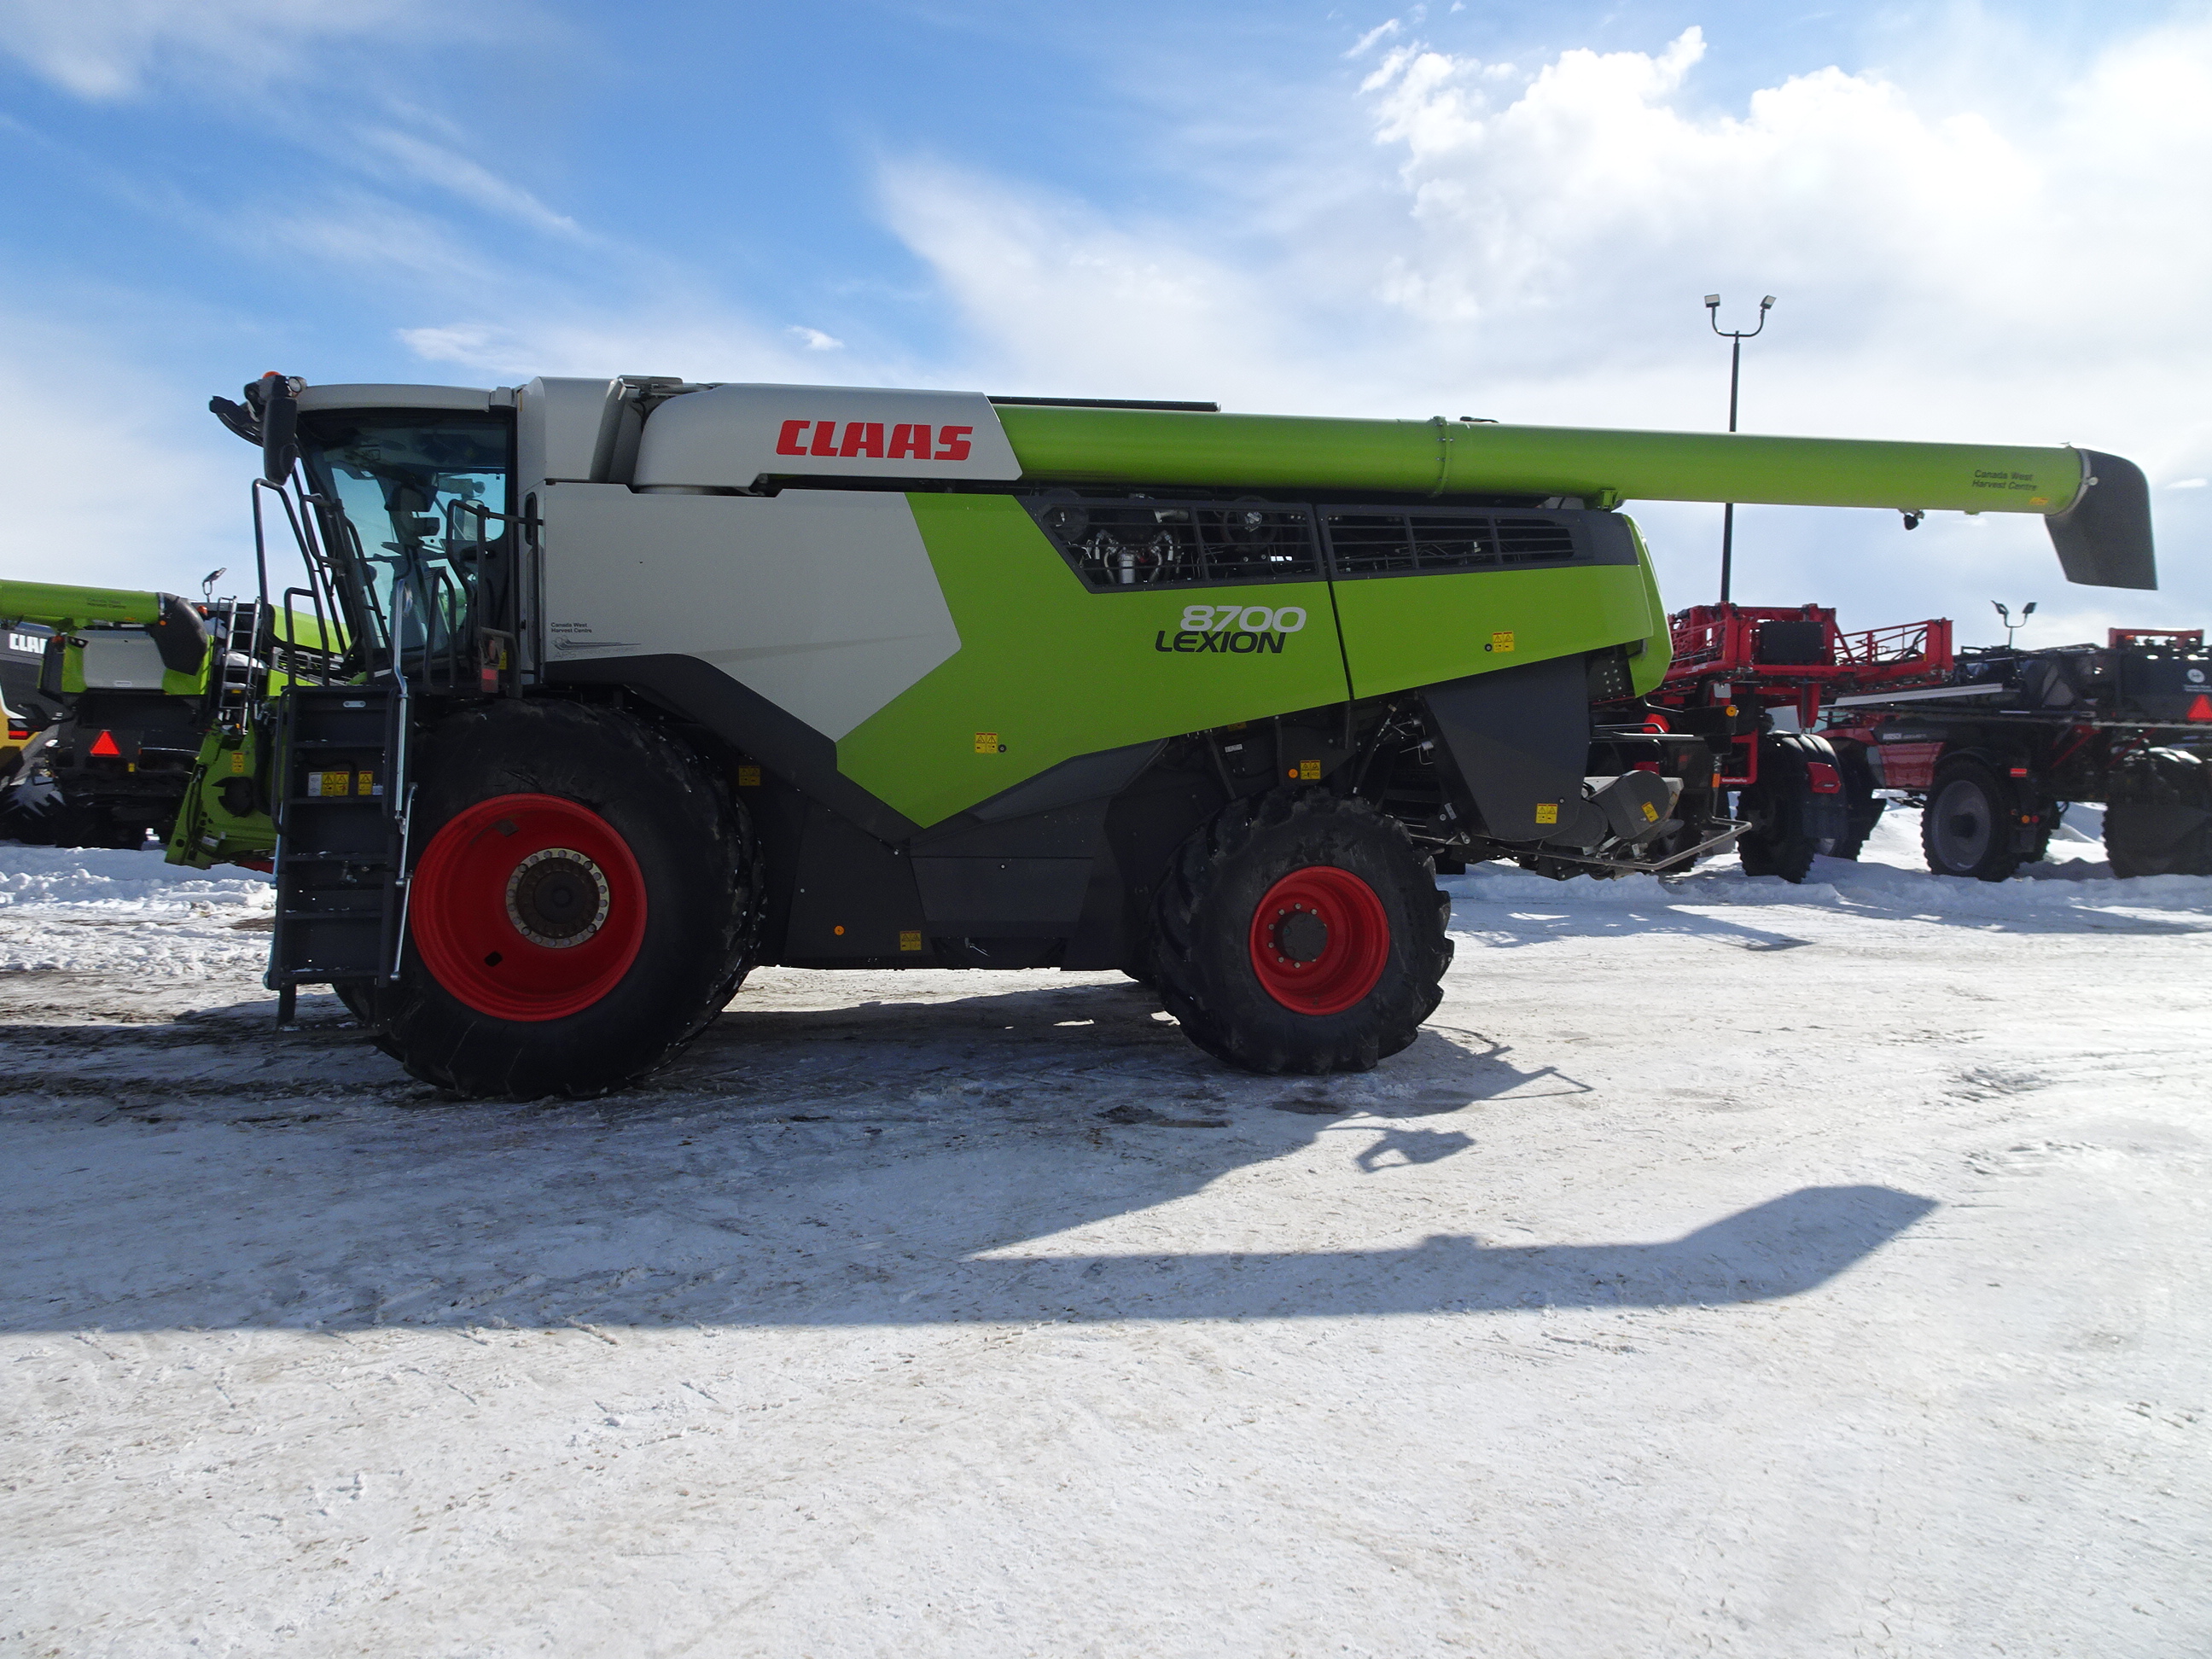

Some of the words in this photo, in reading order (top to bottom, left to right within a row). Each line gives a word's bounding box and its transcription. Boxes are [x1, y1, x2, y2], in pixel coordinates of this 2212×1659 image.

[776, 420, 974, 461] CLAAS
[1972, 480, 2006, 488] Harvest
[2009, 481, 2037, 491] Centre
[1974, 469, 2008, 479] Canada
[2011, 472, 2034, 480] West
[1180, 605, 1307, 632] 8700
[1155, 631, 1286, 653] LEXION
